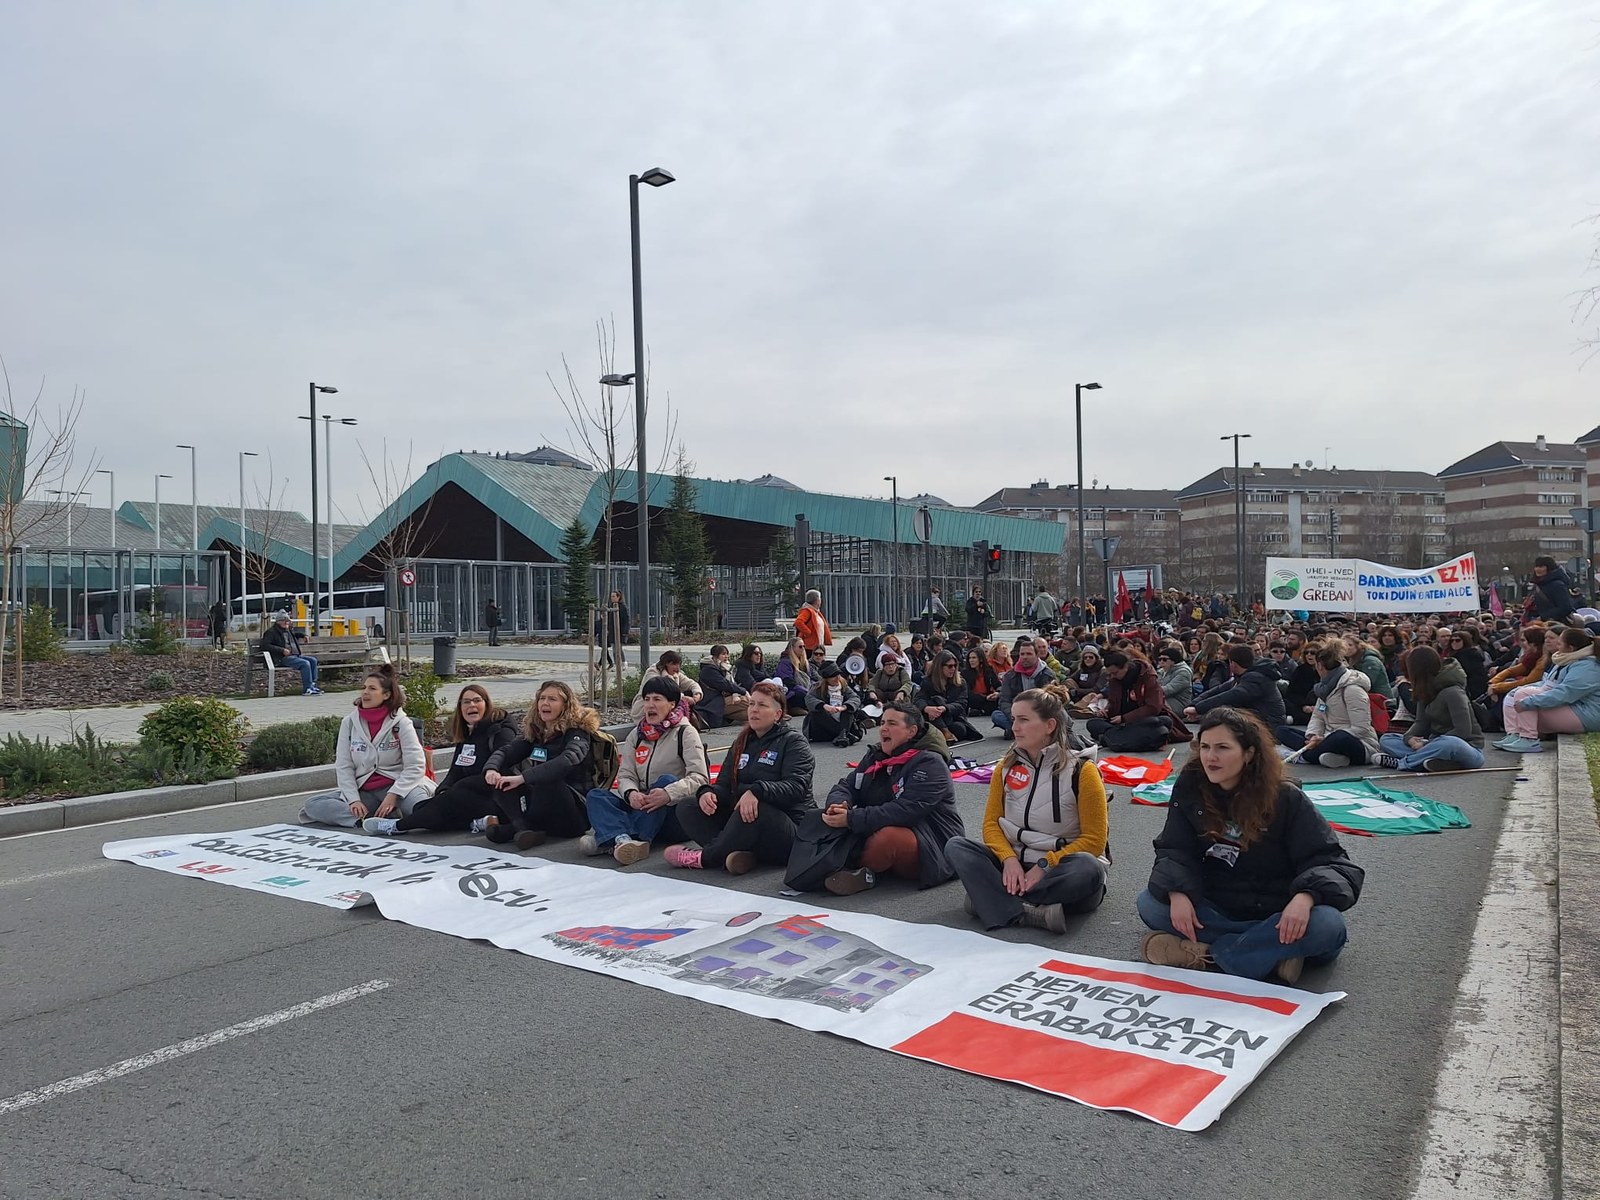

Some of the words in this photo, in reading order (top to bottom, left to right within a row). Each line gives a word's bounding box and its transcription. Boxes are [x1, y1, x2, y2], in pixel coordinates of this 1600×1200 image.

[1305, 567, 1326, 575] UHEI
[1334, 568, 1354, 576] IVED
[1303, 588, 1353, 601] GREBAN
[1366, 590, 1388, 600] TOKI
[1390, 589, 1417, 601] DUIN
[1448, 586, 1473, 598] ALDE
[1009, 769, 1028, 782] LAB
[1014, 971, 1160, 1007] HEMEN
[992, 984, 1078, 1012] ETA
[1103, 1007, 1268, 1051] ORAIN
[967, 996, 1235, 1069] ERABAKITA
